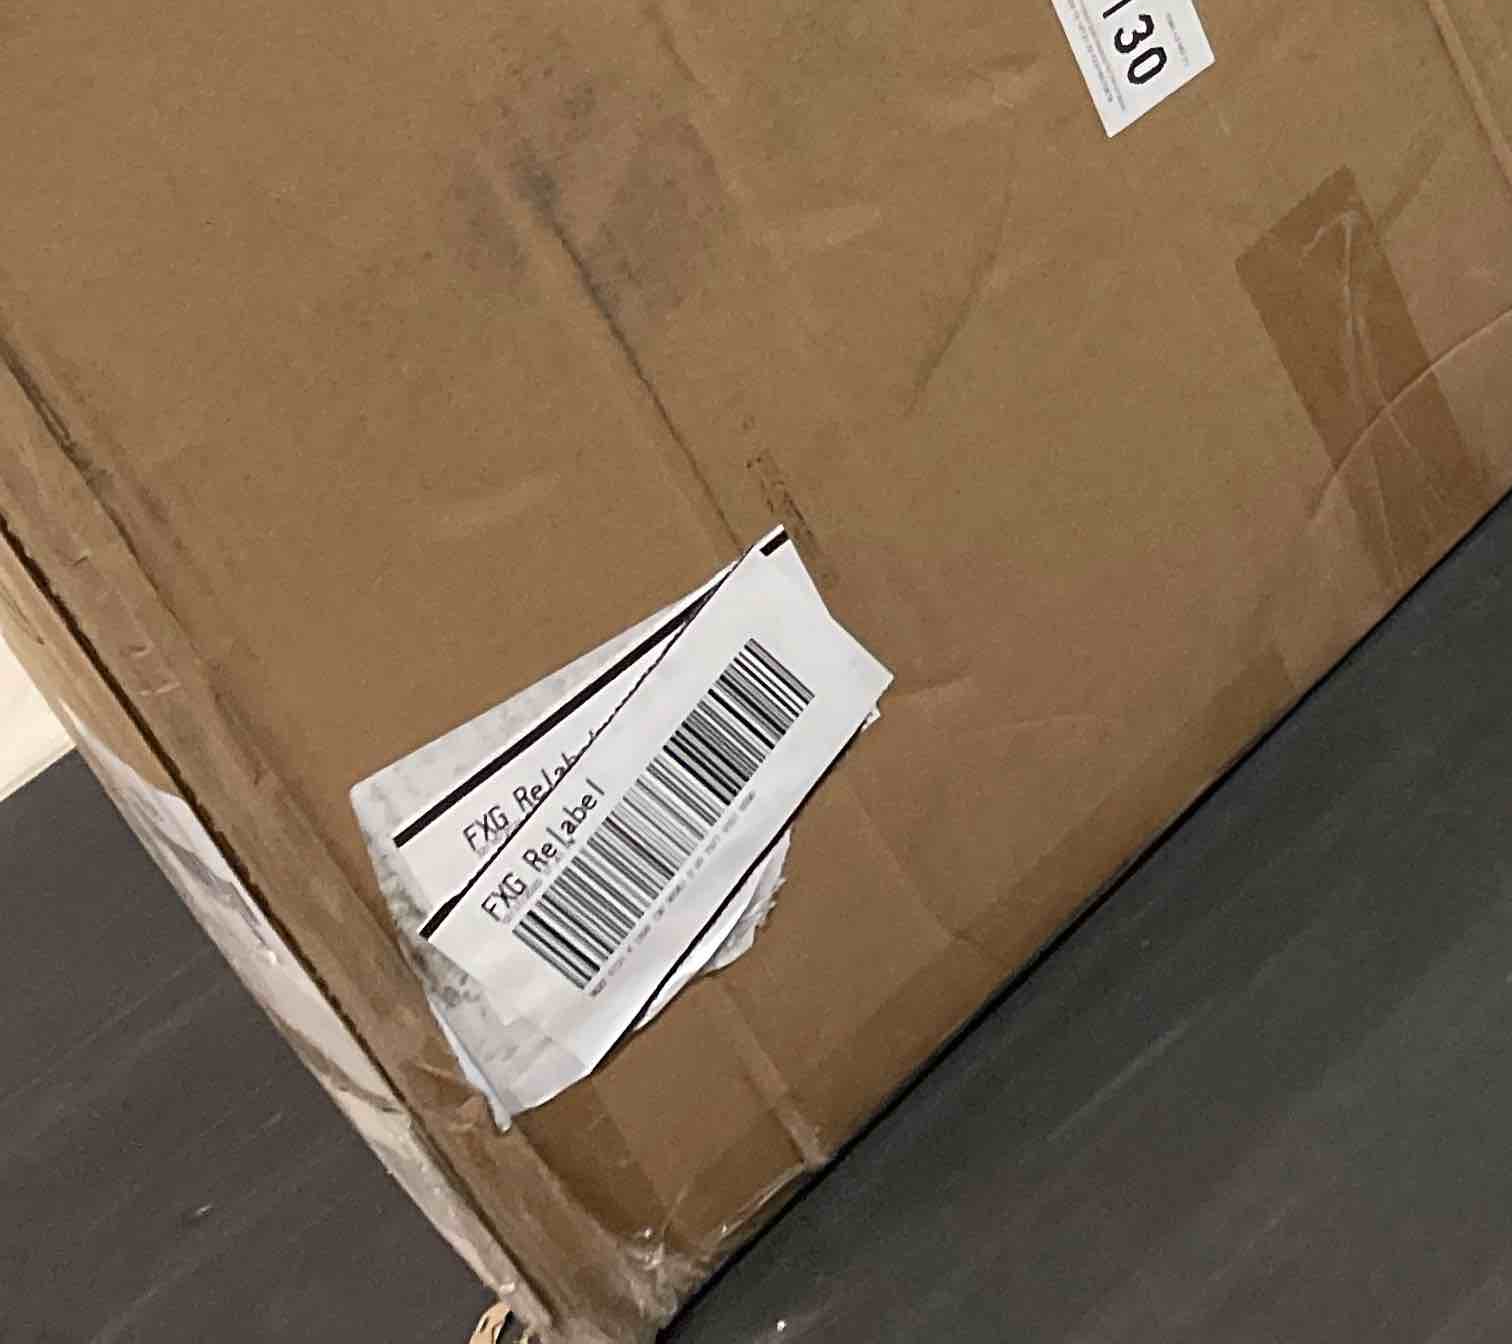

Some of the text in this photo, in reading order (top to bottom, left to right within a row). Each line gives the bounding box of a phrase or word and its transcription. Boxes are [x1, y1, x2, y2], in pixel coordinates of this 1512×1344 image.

[462, 805, 510, 852] FXG
[480, 872, 527, 922] FXG
[521, 778, 605, 873] Relabel
